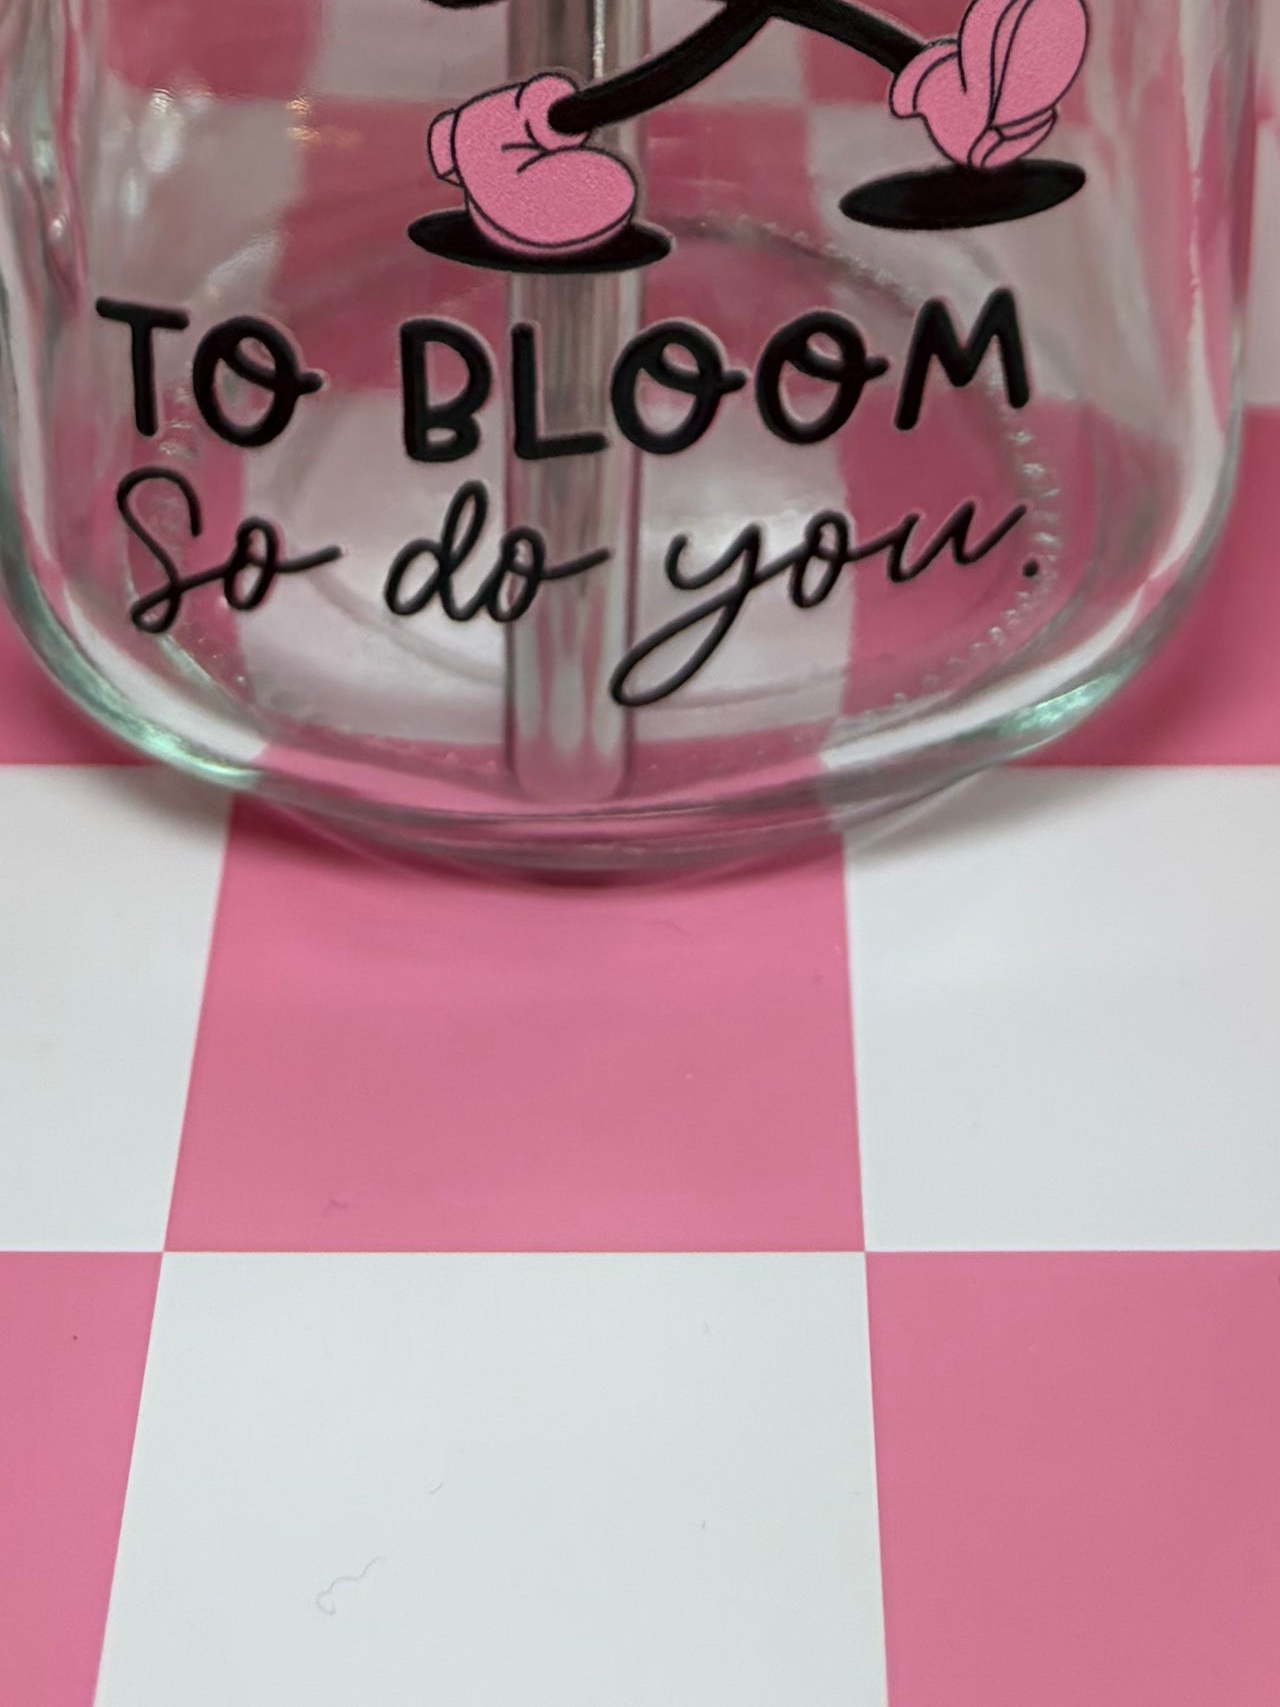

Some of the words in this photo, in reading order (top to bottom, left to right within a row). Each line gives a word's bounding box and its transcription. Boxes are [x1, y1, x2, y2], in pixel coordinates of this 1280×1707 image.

[95, 295, 324, 448] TO
[397, 288, 1032, 462] BLOOM
[116, 466, 342, 633] So
[384, 480, 611, 622] do
[608, 498, 1042, 707] you.
